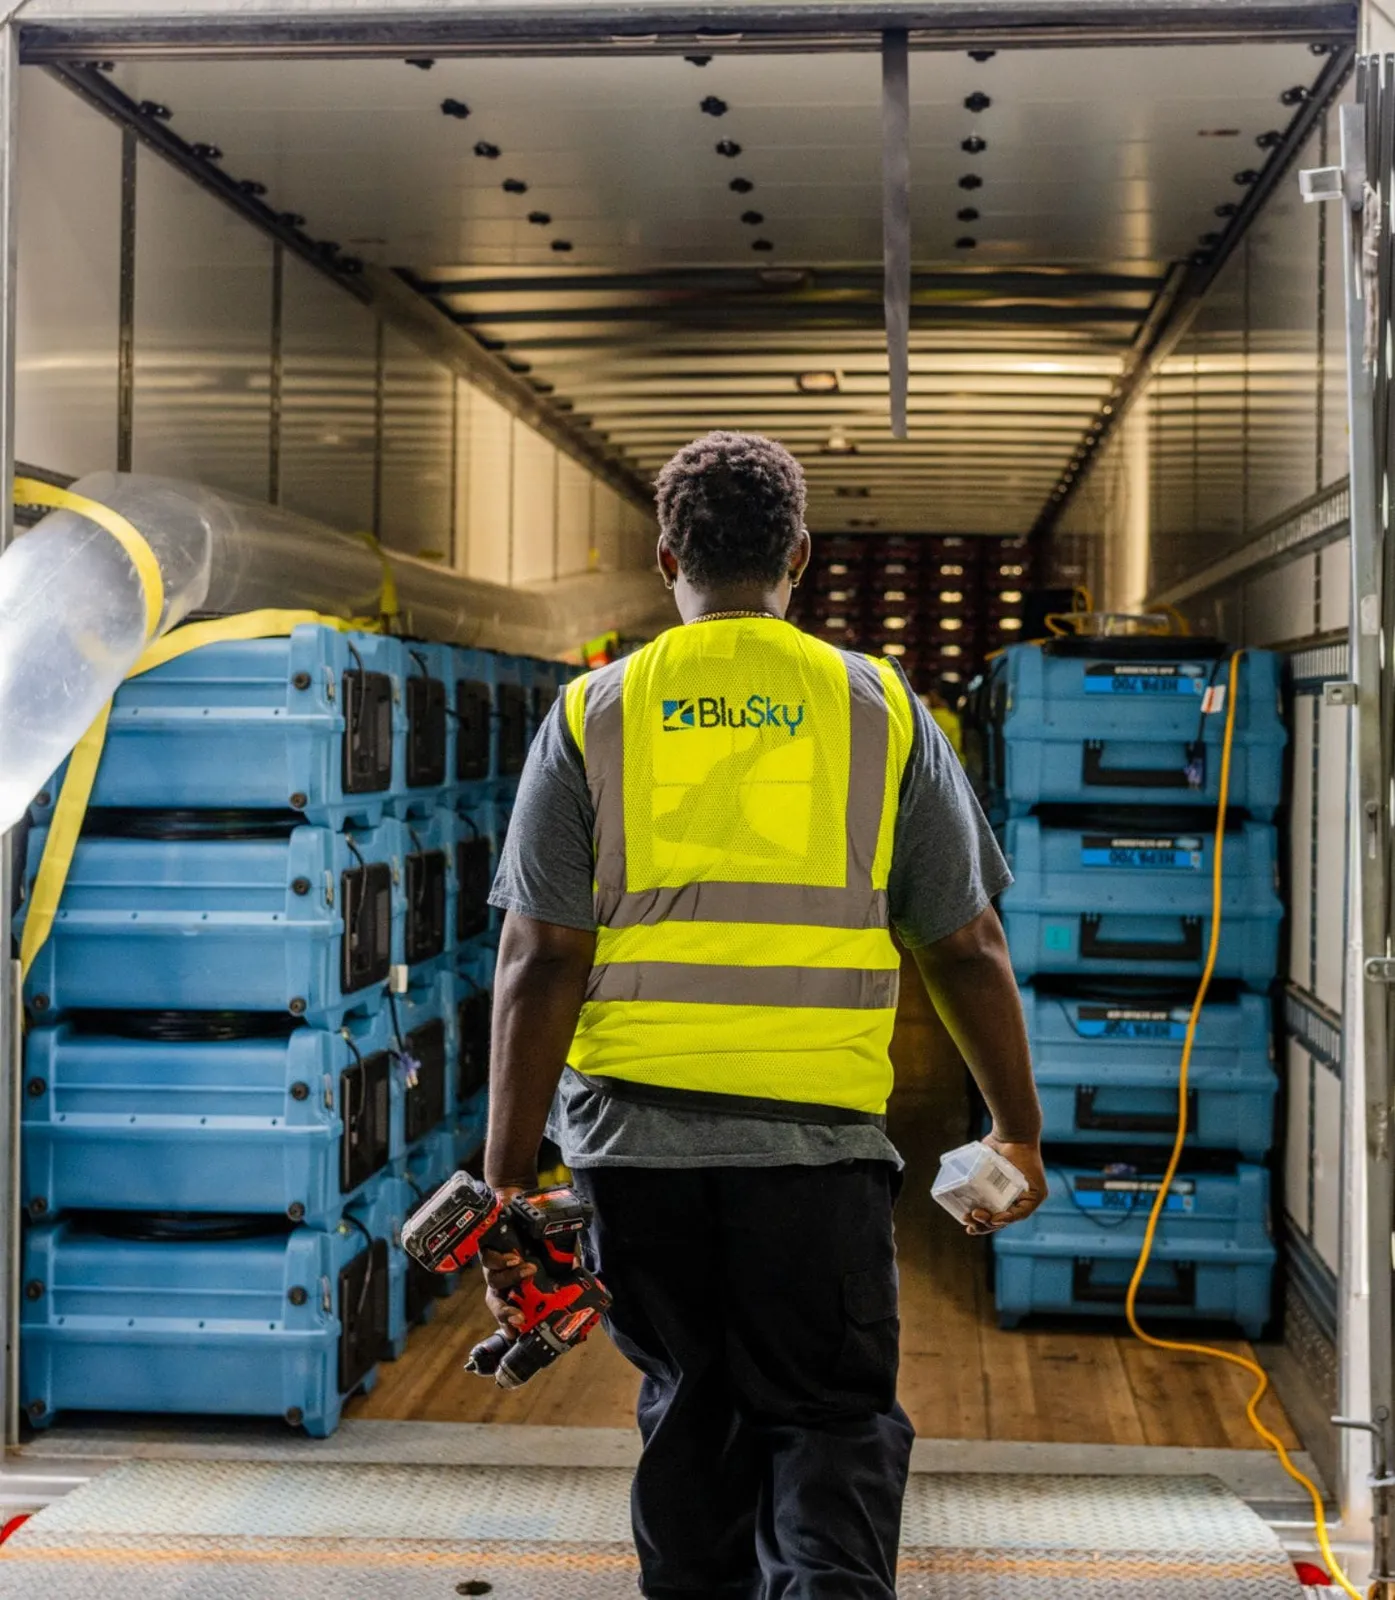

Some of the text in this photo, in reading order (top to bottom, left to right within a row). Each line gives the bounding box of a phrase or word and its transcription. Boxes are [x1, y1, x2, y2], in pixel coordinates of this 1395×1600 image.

[1111, 677, 1178, 692] HEPA 700
[698, 694, 803, 736] BluSky
[1109, 850, 1175, 866] HEPA 700
